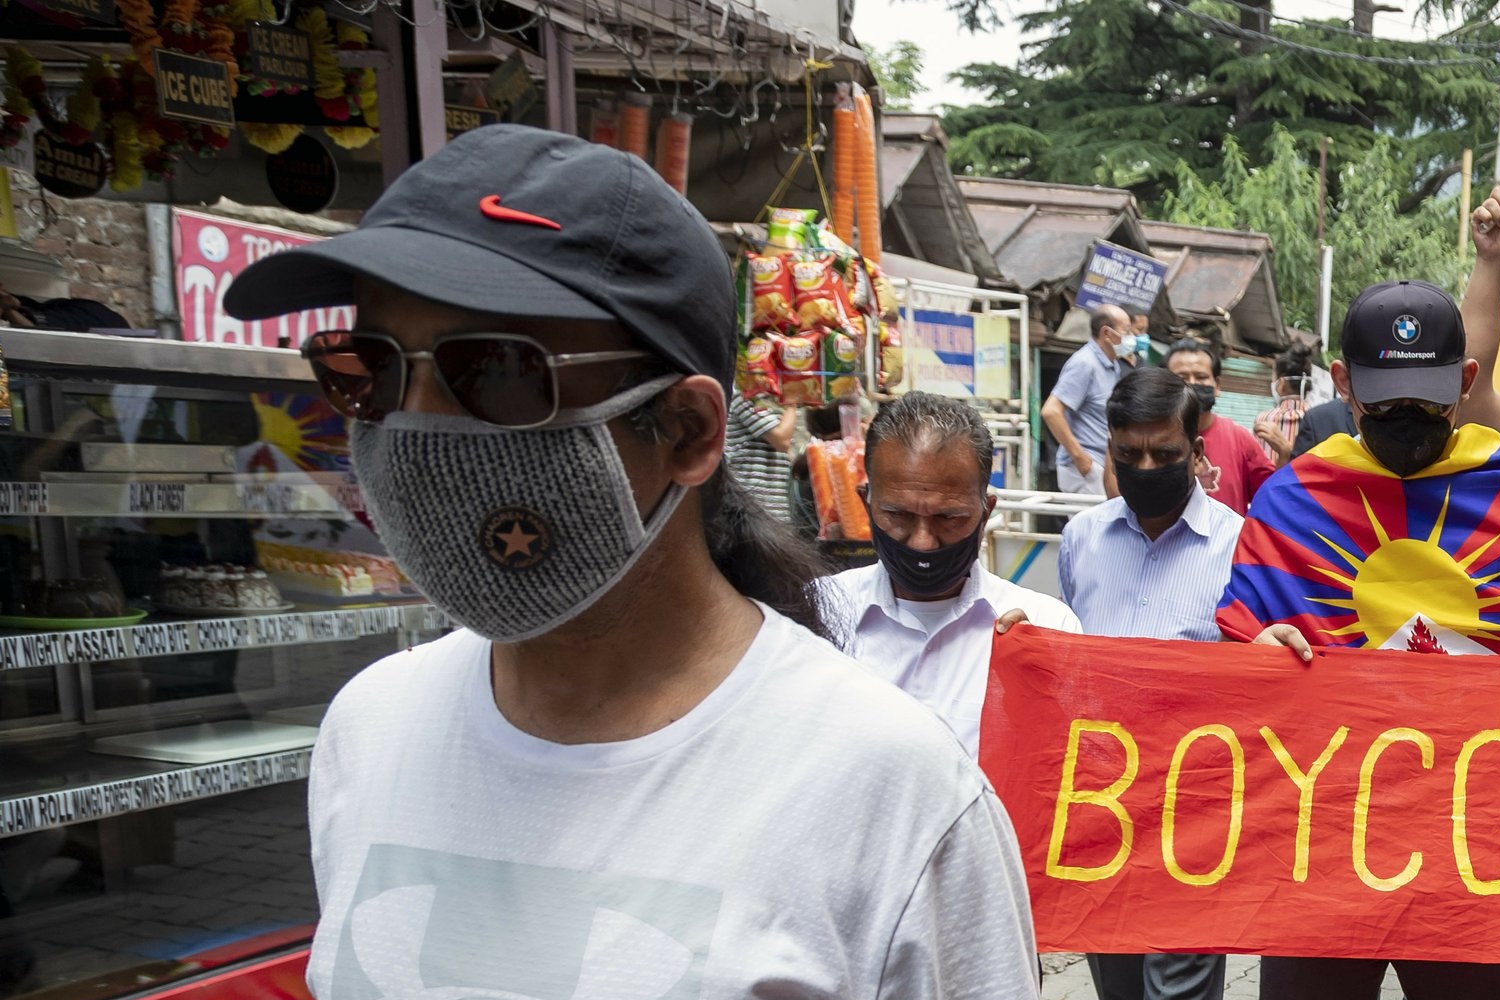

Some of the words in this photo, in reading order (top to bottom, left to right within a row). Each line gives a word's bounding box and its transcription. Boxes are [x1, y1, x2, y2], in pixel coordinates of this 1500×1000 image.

[252, 27, 271, 54] ICE
[271, 30, 309, 60] CREAM
[160, 70, 188, 103] ICE
[189, 77, 230, 110] CUBE
[445, 109, 481, 130] RESH
[0, 637, 21, 668] AY
[21, 632, 61, 667] NIGHT
[64, 628, 128, 663] CASSATA
[131, 624, 166, 656] CHOCO
[166, 622, 190, 652] BITE
[134, 773, 166, 811] SWISS
[166, 770, 193, 801] ROLL
[7, 798, 36, 833] JAM
[38, 791, 75, 825] ROLL
